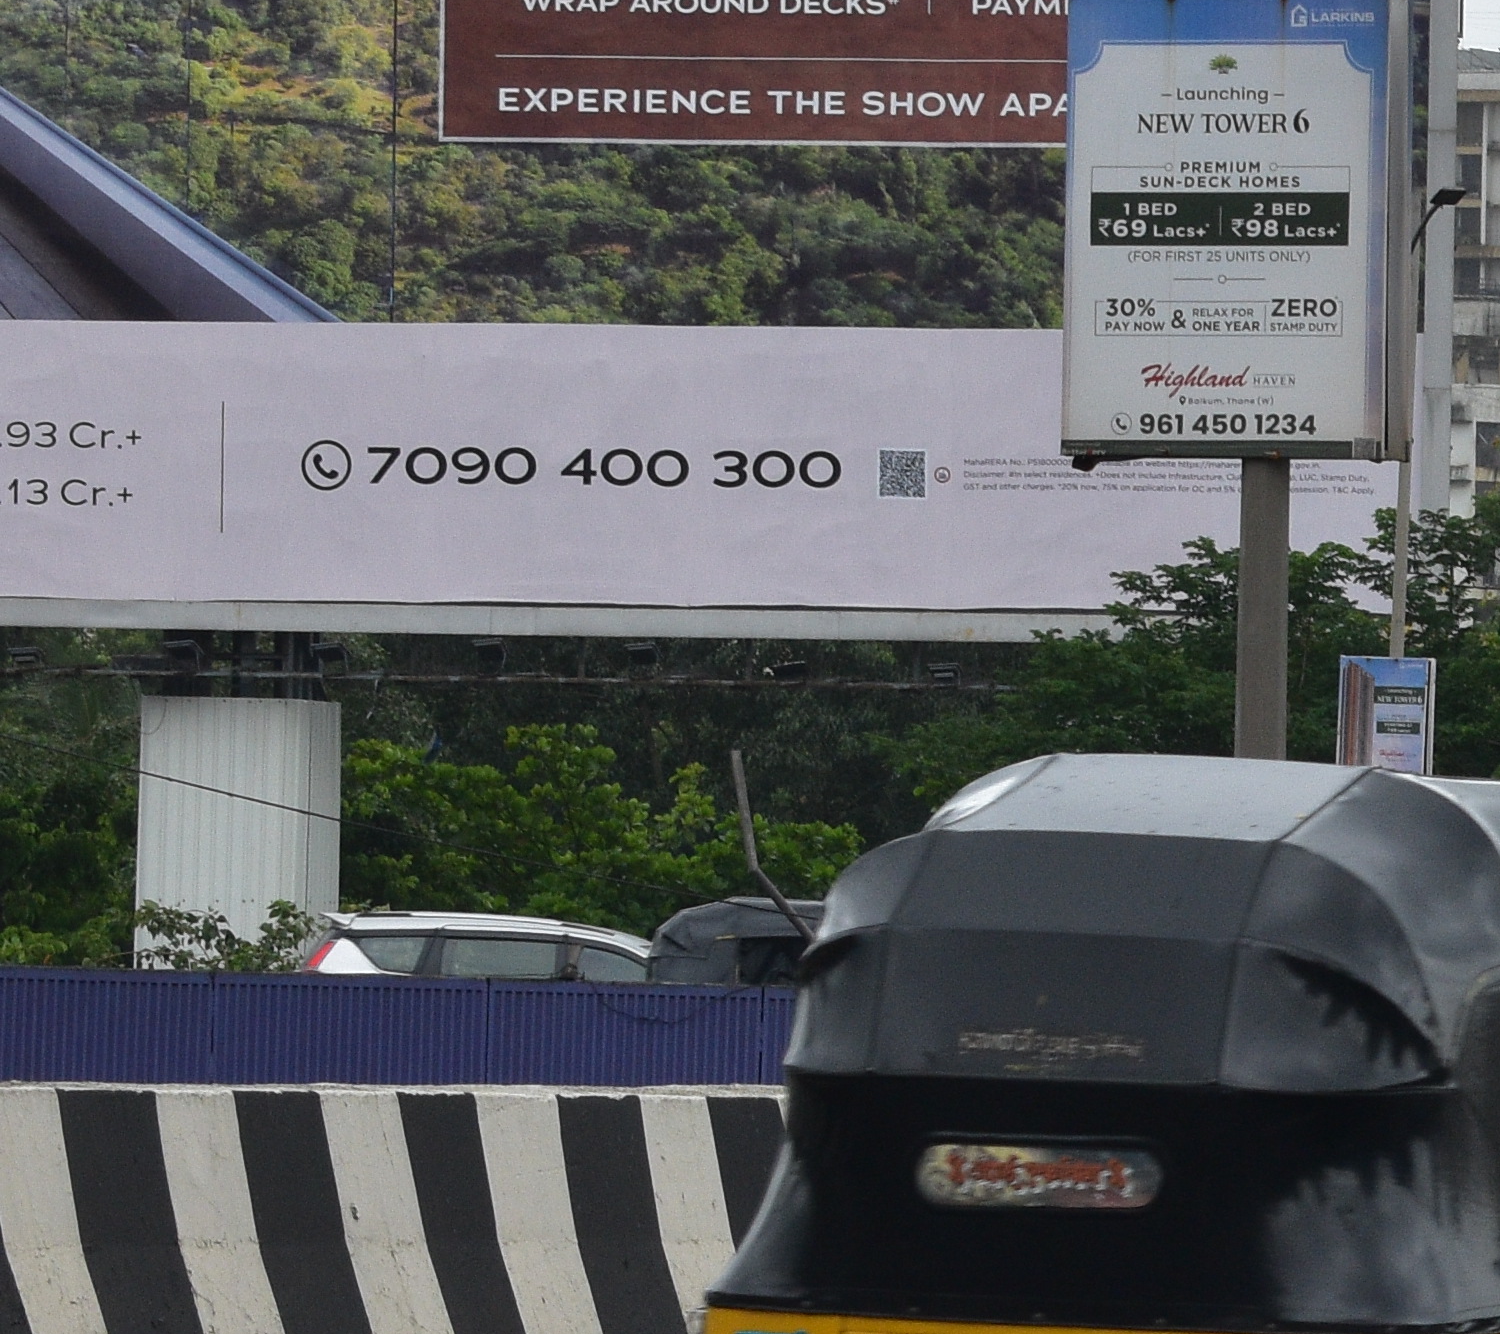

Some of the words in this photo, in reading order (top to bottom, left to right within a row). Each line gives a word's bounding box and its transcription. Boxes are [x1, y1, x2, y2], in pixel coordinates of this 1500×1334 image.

[1311, 11, 1375, 23] LARKINS
[497, 86, 752, 116] EXPERIENCE
[767, 89, 845, 116] THE
[861, 91, 986, 118] SHOW
[1176, 86, 1269, 105] Launching
[1137, 112, 1196, 135] NEW
[1201, 112, 1288, 135] TOWER
[1292, 108, 1310, 135] 6
[1180, 160, 1262, 174] PREMIUM
[1139, 176, 1232, 189] SUN-DECK
[1239, 176, 1301, 189] HOMES
[1123, 202, 1131, 216] 1
[1137, 202, 1178, 216] BED
[1253, 202, 1265, 216] 2
[1271, 202, 1312, 216] BED
[1127, 250, 1162, 264] (FOR
[1164, 251, 1202, 263] FIRST
[1206, 251, 1223, 263] 25
[1226, 251, 1266, 263] UNITS
[1269, 250, 1312, 264] ONLY)
[1105, 297, 1157, 318] 30%
[1192, 307, 1229, 318] RELAX
[1231, 307, 1254, 318] FOR
[1105, 320, 1132, 332] PAY
[1133, 320, 1166, 332] NOW
[1171, 308, 1187, 331] &
[1192, 320, 1221, 333] ONE
[1222, 320, 1261, 333] YEAR
[1269, 322, 1306, 333] STAMP
[1308, 322, 1338, 333] DUTY
[1140, 361, 1251, 399] Highland
[1253, 375, 1296, 385] HAVEN
[1139, 413, 1184, 435] 961
[1191, 413, 1247, 435] 450
[1254, 413, 1318, 436] 1234
[69, 421, 142, 450] Cr.+
[366, 444, 538, 486] 7090
[560, 446, 690, 488] 400
[712, 448, 843, 489] 300
[0, 478, 48, 505] 13
[60, 478, 133, 507] Cr.+
